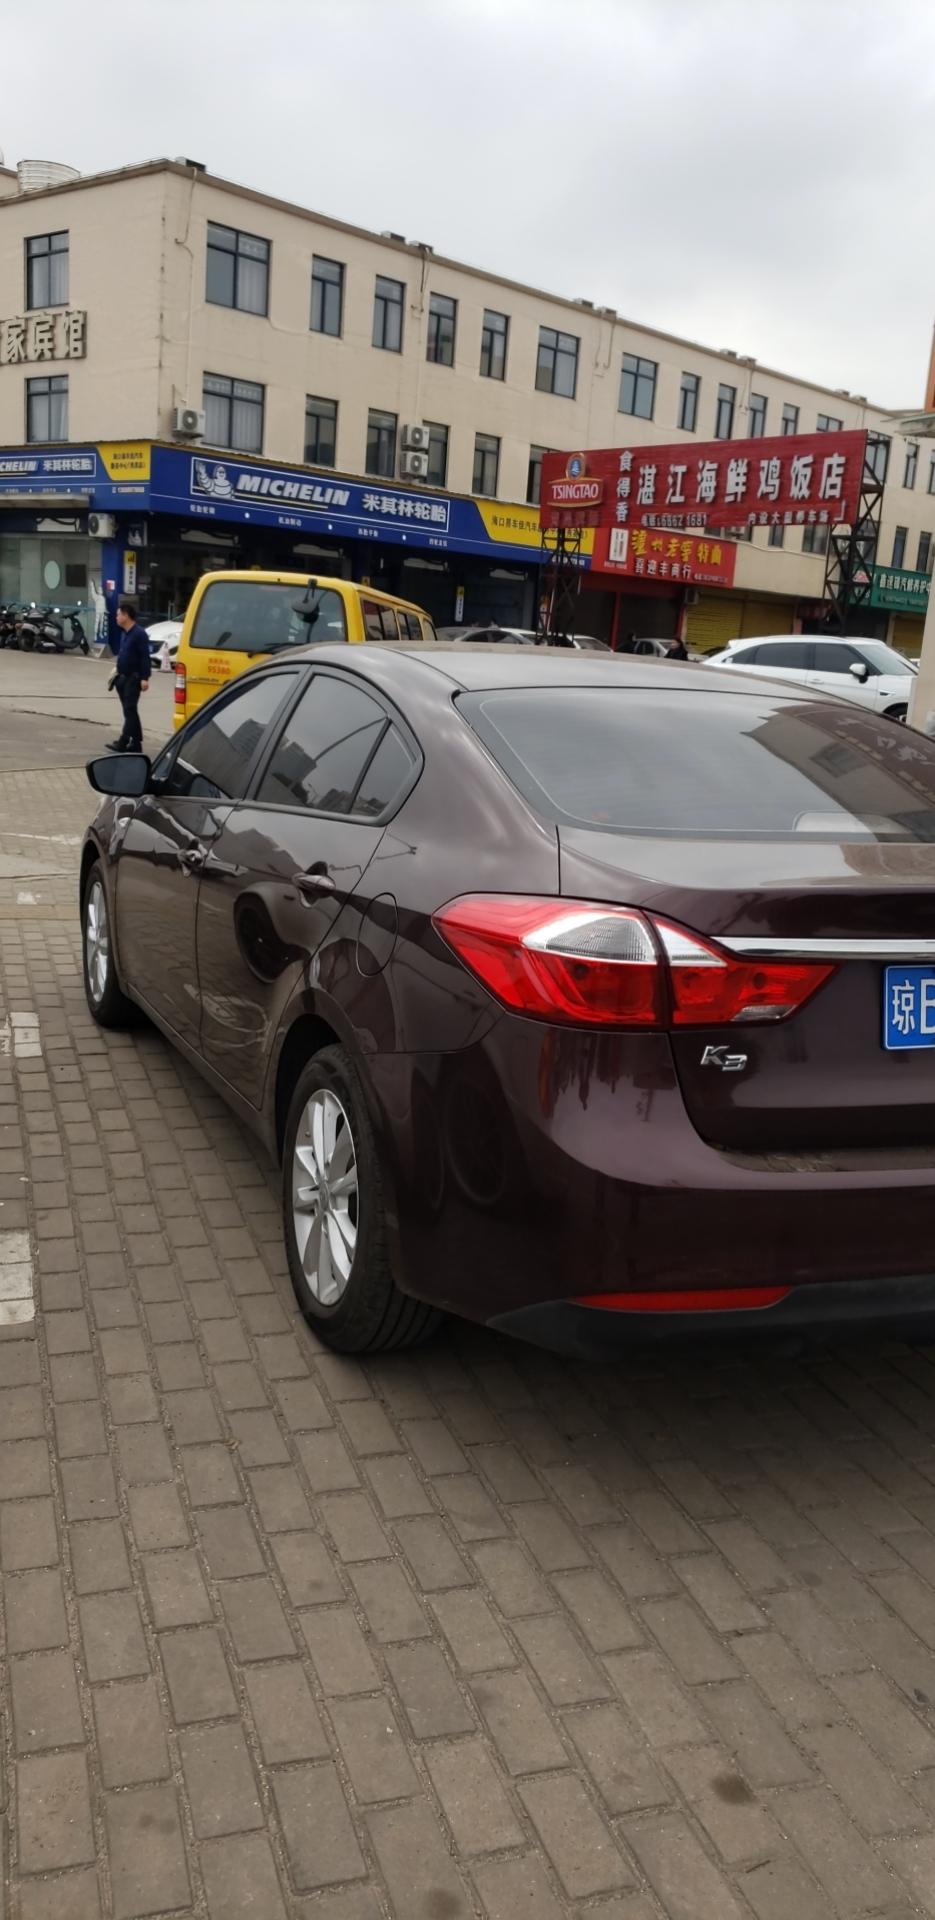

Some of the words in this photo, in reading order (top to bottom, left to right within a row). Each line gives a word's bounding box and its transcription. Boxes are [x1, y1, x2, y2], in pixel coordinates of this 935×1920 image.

[43, 458, 92, 471] 米其林轮胎
[637, 452, 846, 505] 湛江海鲜鸡饭店
[237, 474, 350, 506] MICHELIN
[362, 494, 446, 523] 米其林轮胎
[552, 483, 599, 499] TSINGTAO
[616, 450, 633, 522] 食得香
[701, 1046, 748, 1071] K3
